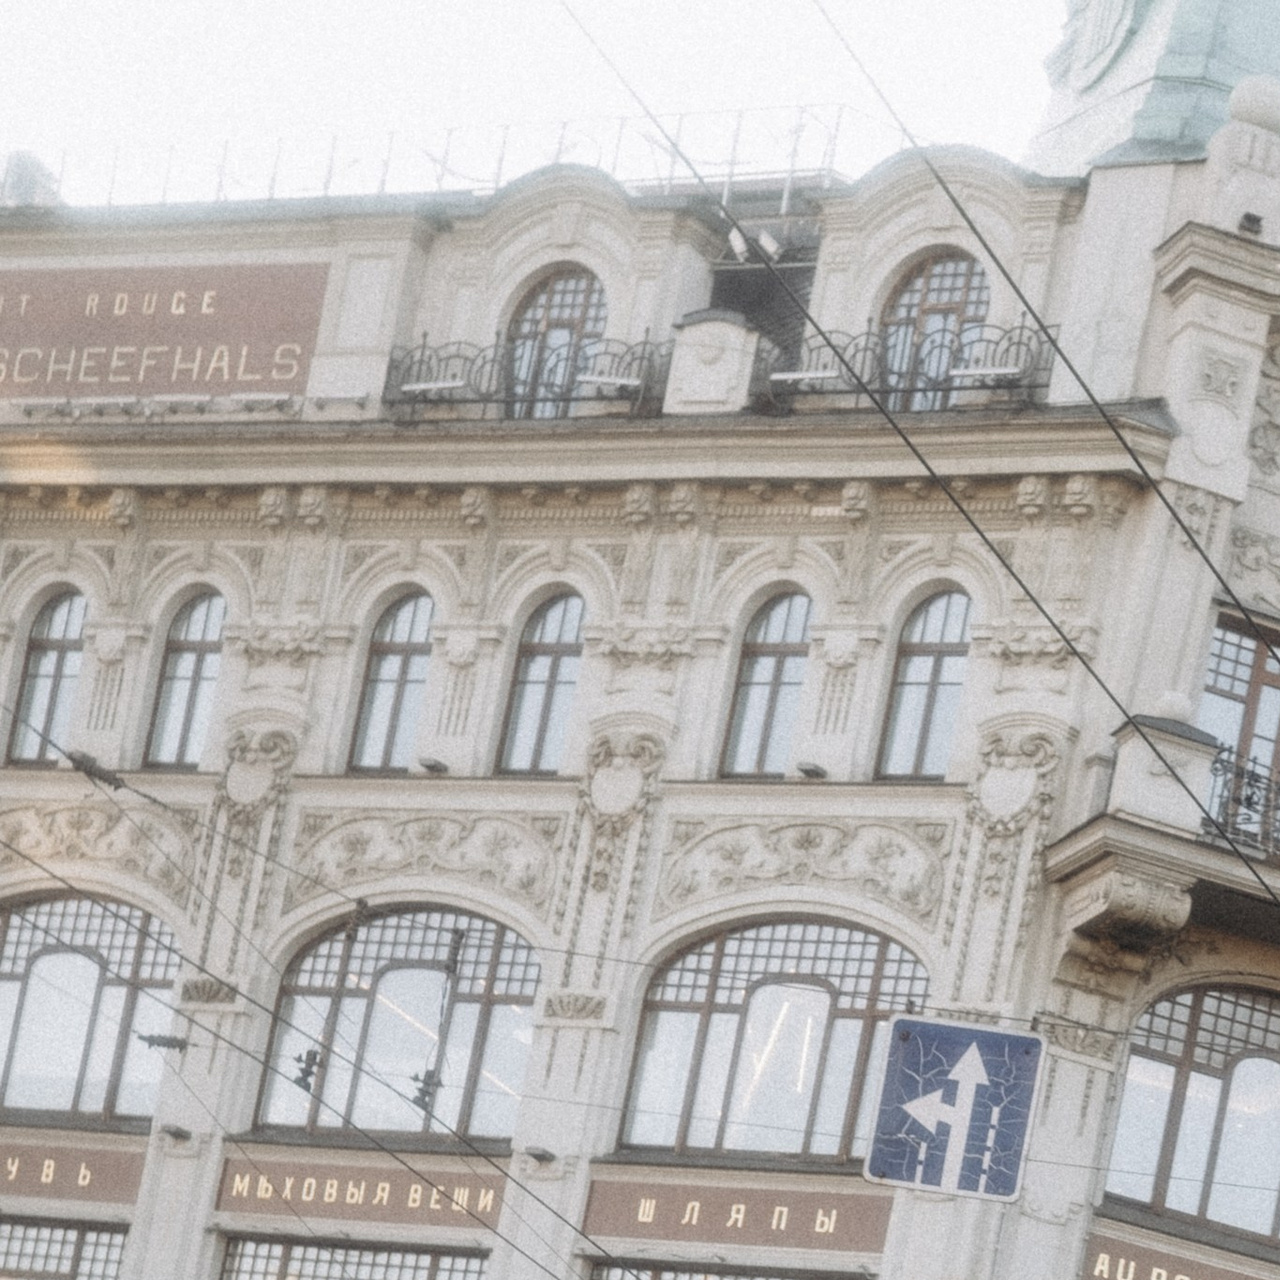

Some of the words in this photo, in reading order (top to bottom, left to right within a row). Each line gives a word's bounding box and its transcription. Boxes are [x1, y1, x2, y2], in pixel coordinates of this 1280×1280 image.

[85, 290, 217, 317] ROUGE
[407, 1183, 495, 1215] ВЕЩИ
[637, 1197, 838, 1234] ШЛЯПЫ
